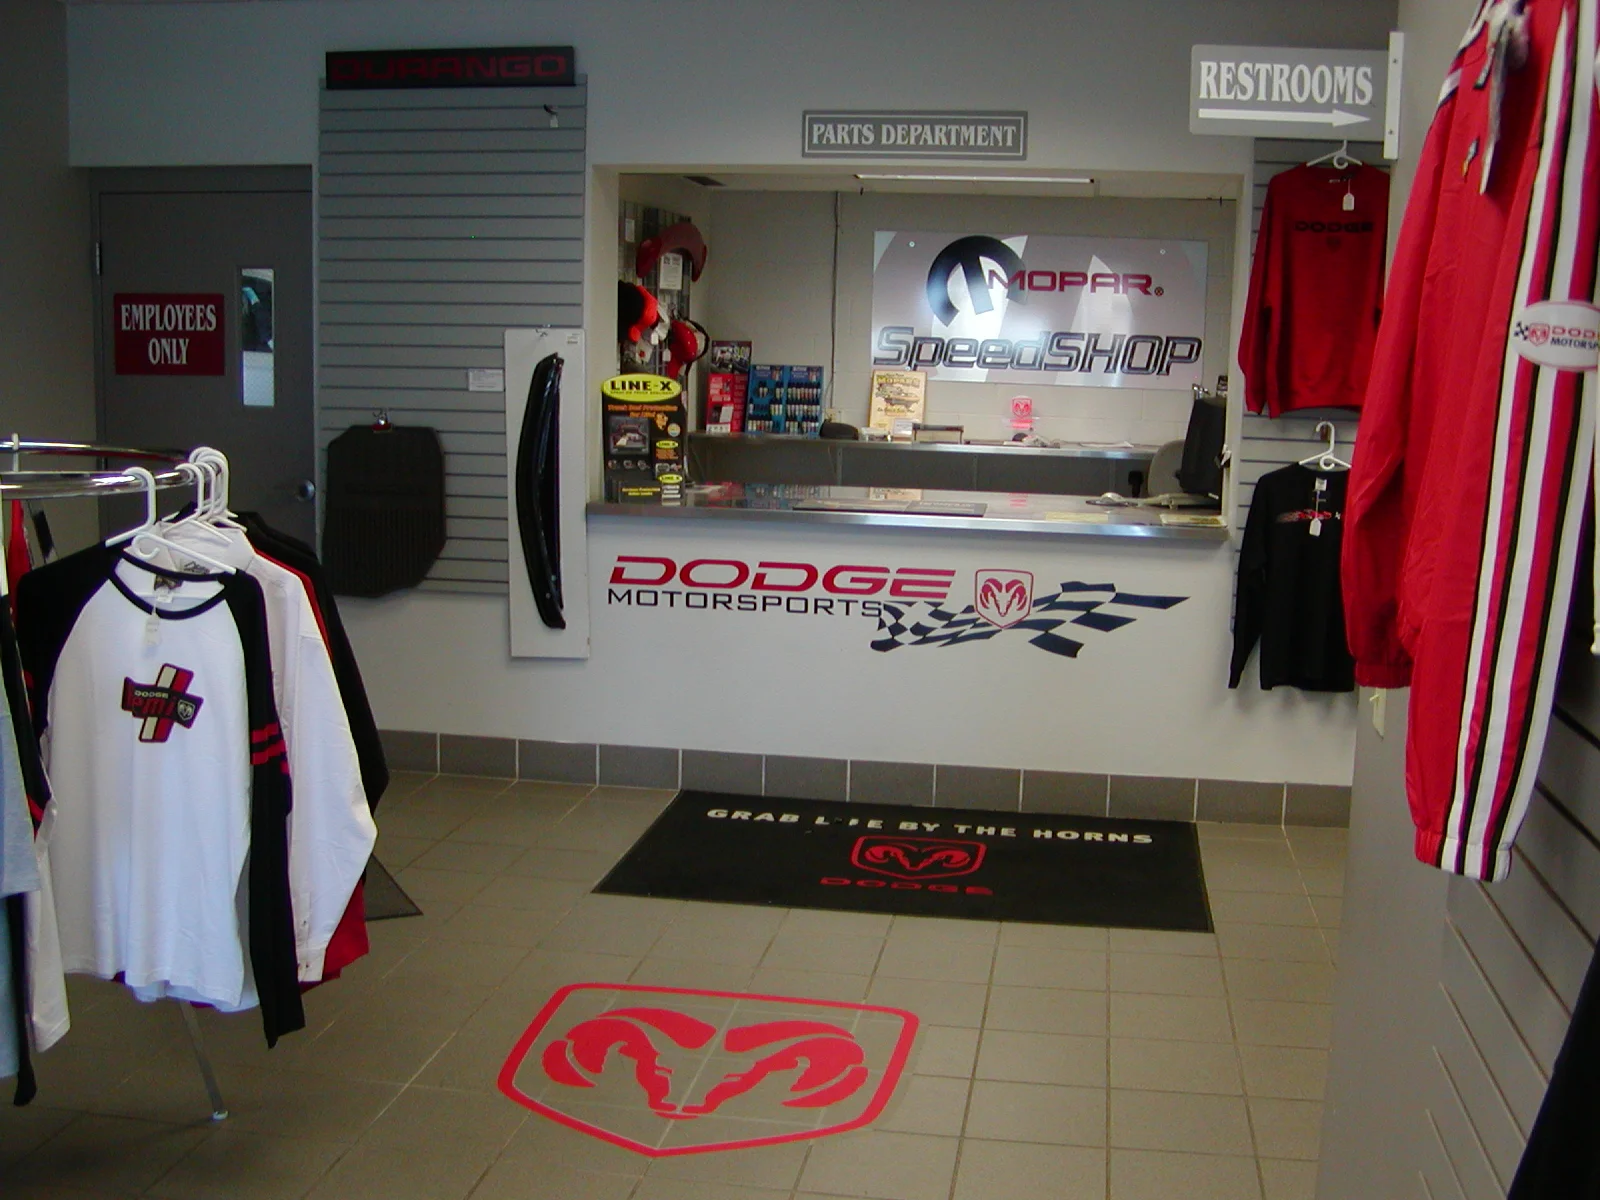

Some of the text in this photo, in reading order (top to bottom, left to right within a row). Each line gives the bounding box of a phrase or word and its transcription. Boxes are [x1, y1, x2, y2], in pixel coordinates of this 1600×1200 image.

[331, 55, 567, 81] DURANGO
[1199, 60, 1373, 106] RESTROOMS
[812, 123, 1017, 147] PARTS DEPARTMENT
[1294, 220, 1374, 233] DODGE
[121, 303, 217, 332] EMPLOYEES
[1552, 326, 1599, 340] DOD
[148, 337, 190, 365] ONLY
[609, 555, 956, 599] DODGE
[607, 588, 883, 617] MOTORSPORTS
[134, 690, 169, 699] DODGE
[707, 809, 1153, 844] GRAB LFE BY THE HORNS
[820, 877, 994, 895] DODGE
